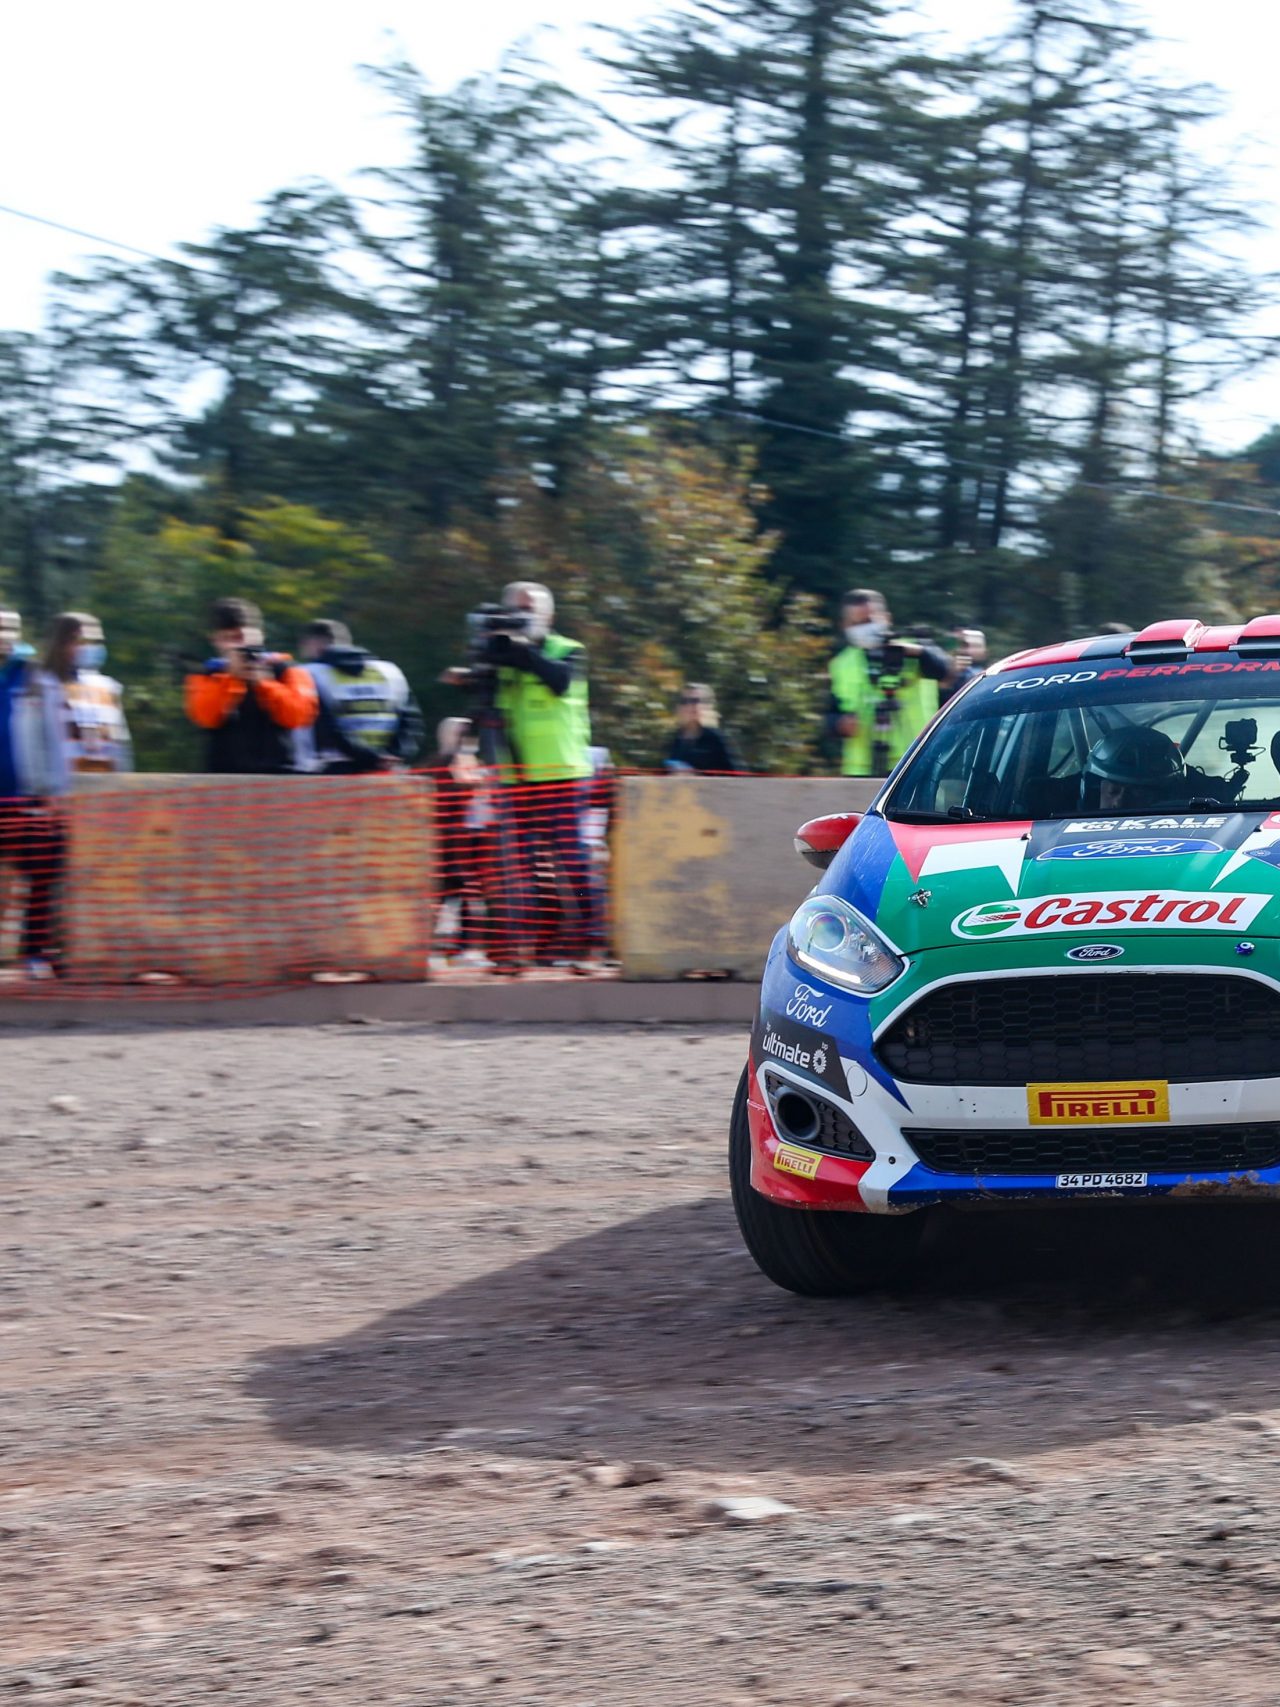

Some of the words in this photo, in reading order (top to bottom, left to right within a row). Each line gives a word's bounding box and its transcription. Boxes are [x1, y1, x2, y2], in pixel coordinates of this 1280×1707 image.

[993, 671, 1098, 693] FORD
[1119, 816, 1228, 827] KALE
[1073, 840, 1187, 857] Ford
[1024, 894, 1247, 929] Castrol
[1078, 947, 1110, 958] Ford
[786, 983, 833, 1028] Ford
[762, 1032, 811, 1069] ultimate
[1038, 1089, 1156, 1118] PIRELLI
[777, 1148, 816, 1174] PIRELLI
[1060, 1175, 1079, 1186] 34
[1081, 1174, 1102, 1186] PD
[1105, 1173, 1143, 1185] 4682
